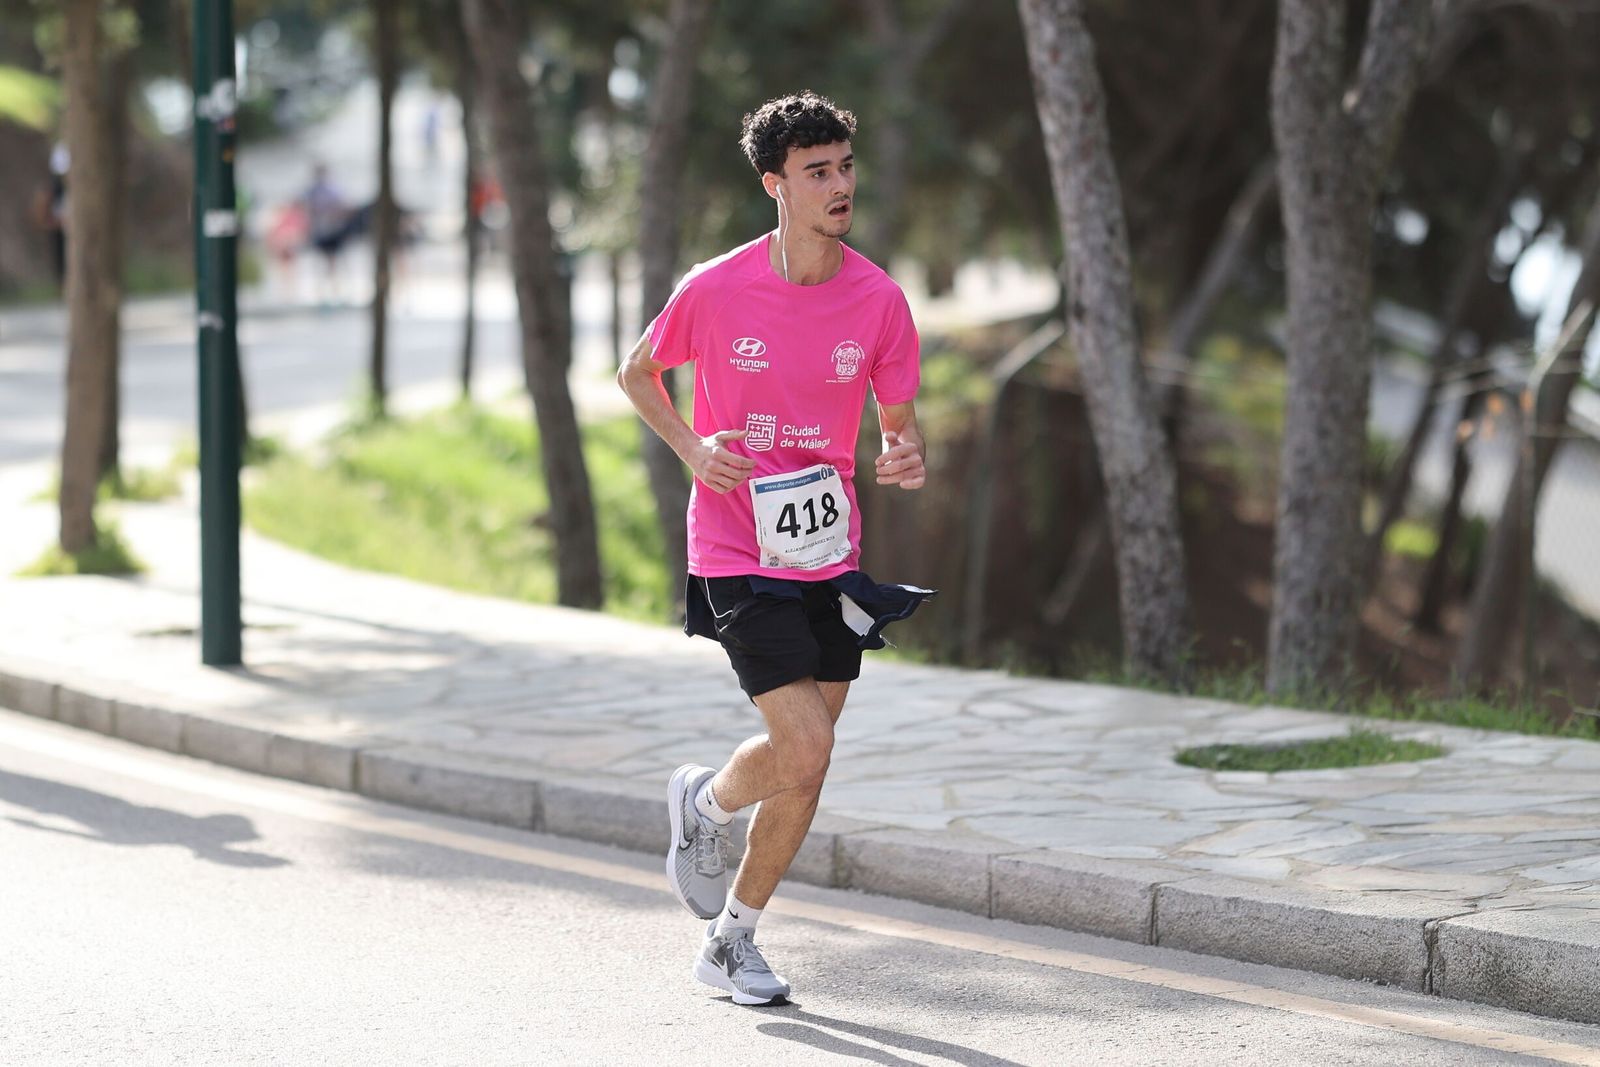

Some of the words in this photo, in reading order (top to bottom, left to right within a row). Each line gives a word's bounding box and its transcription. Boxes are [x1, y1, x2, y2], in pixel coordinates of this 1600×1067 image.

[729, 358, 769, 369] HYUNDAI
[782, 424, 820, 436] Ciudad
[780, 438, 795, 448] de
[776, 492, 839, 538] 418
